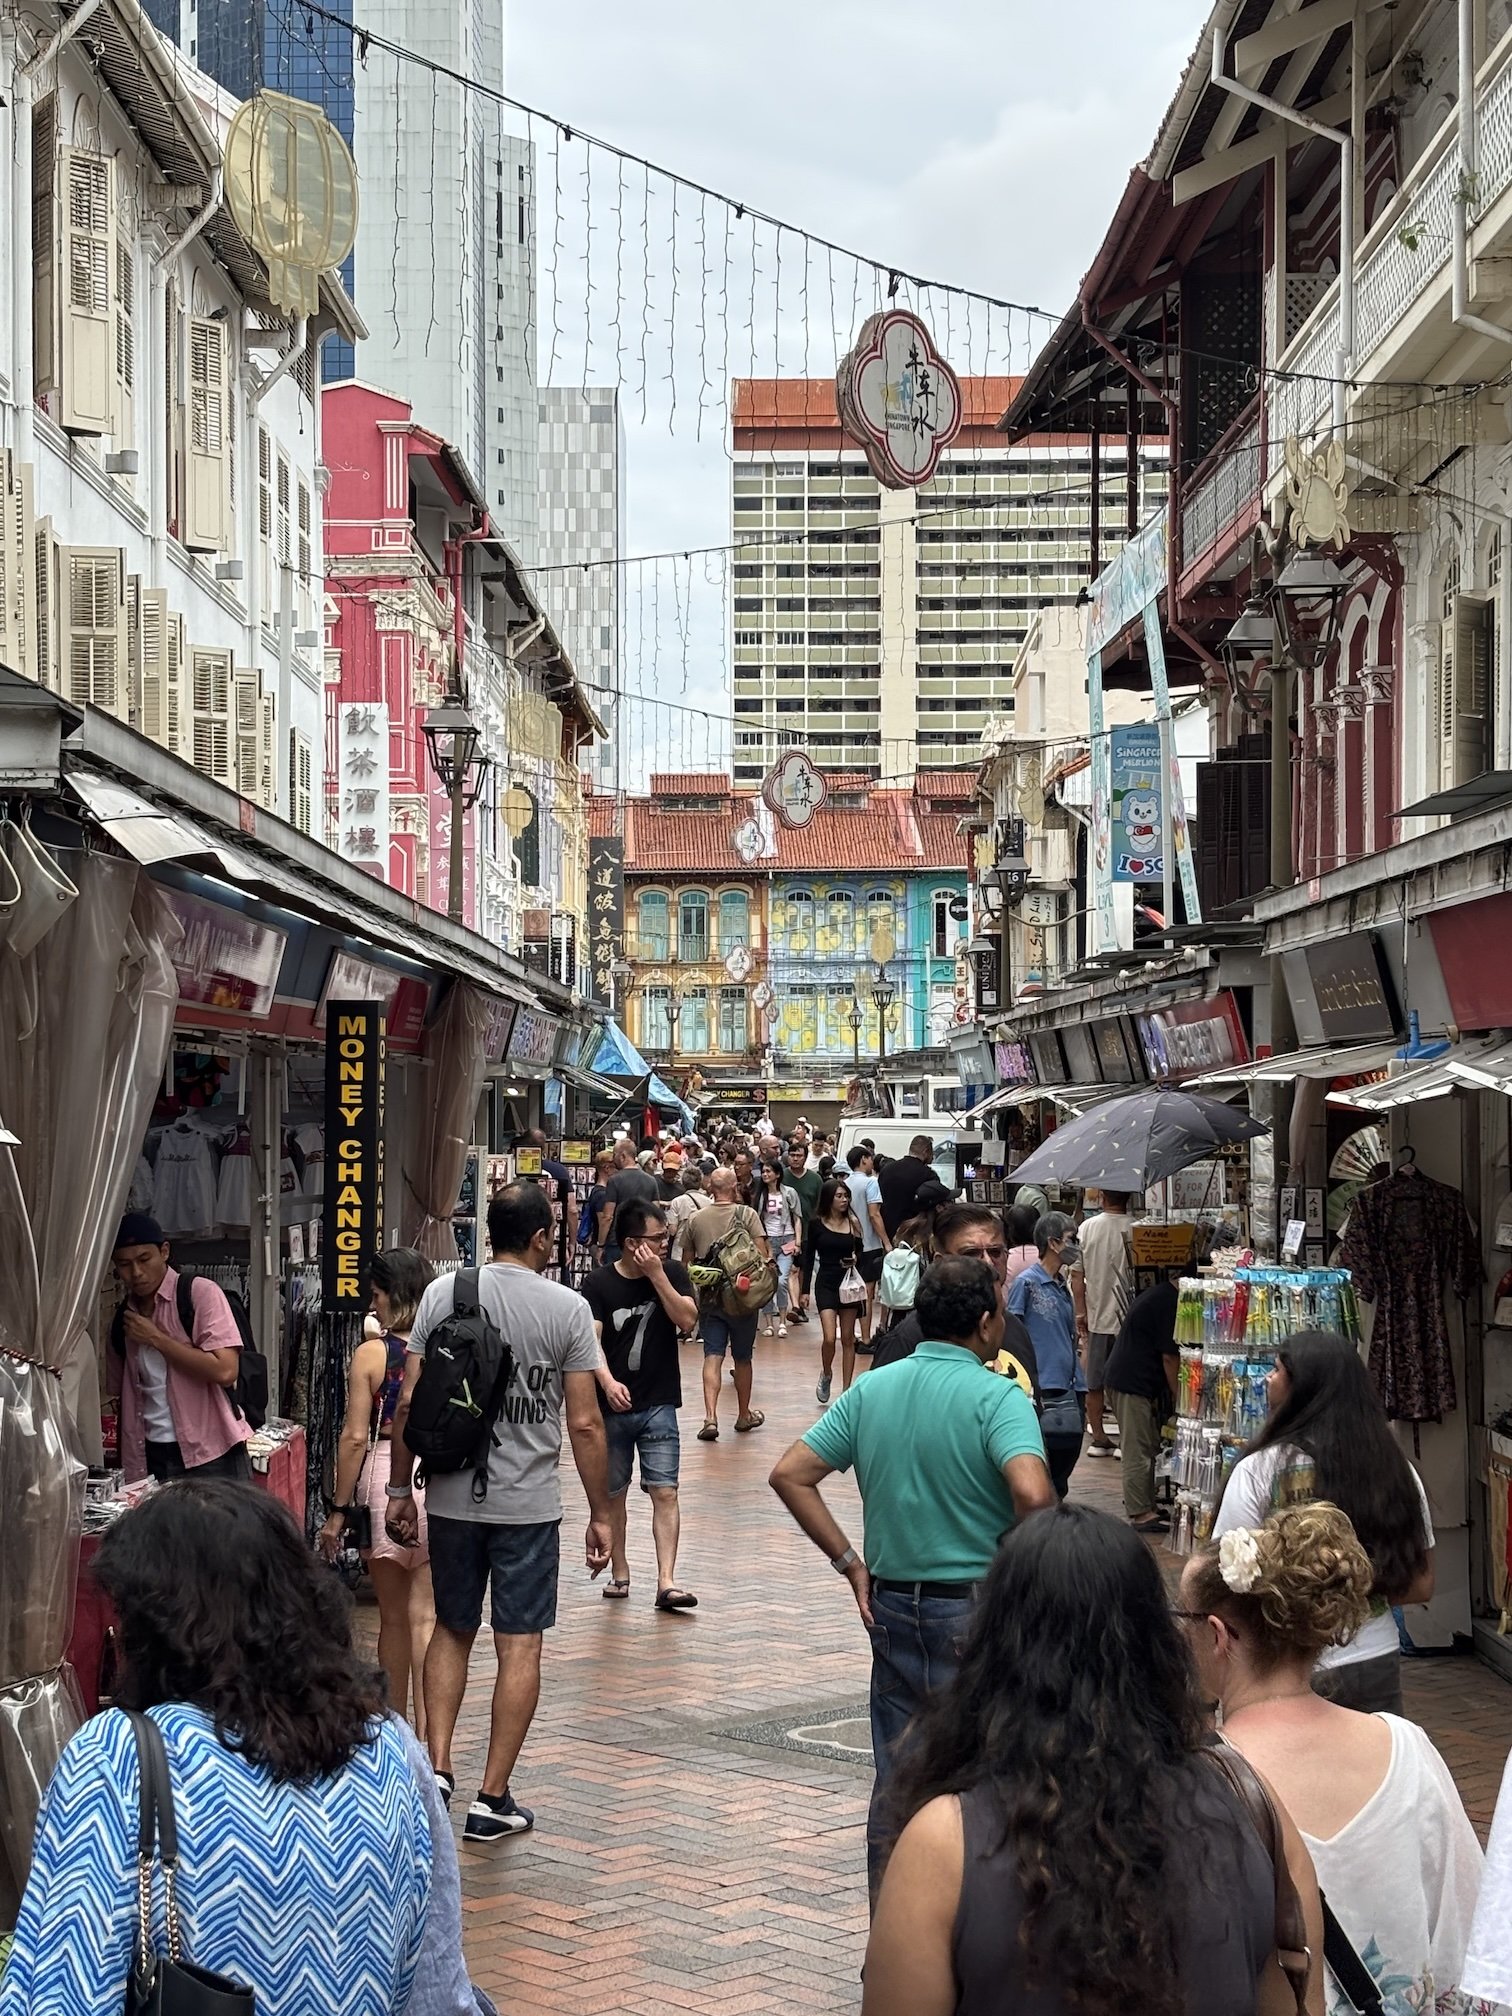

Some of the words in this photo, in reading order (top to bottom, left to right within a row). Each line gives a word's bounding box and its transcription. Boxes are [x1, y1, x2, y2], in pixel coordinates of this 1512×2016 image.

[338, 1015, 367, 1127] MONEY
[378, 1016, 387, 1128] MONEY
[720, 1089, 750, 1099] CHANGER
[336, 1140, 363, 1297] CHANGER
[375, 1140, 385, 1252] CHANG
[527, 1365, 557, 1392] OF
